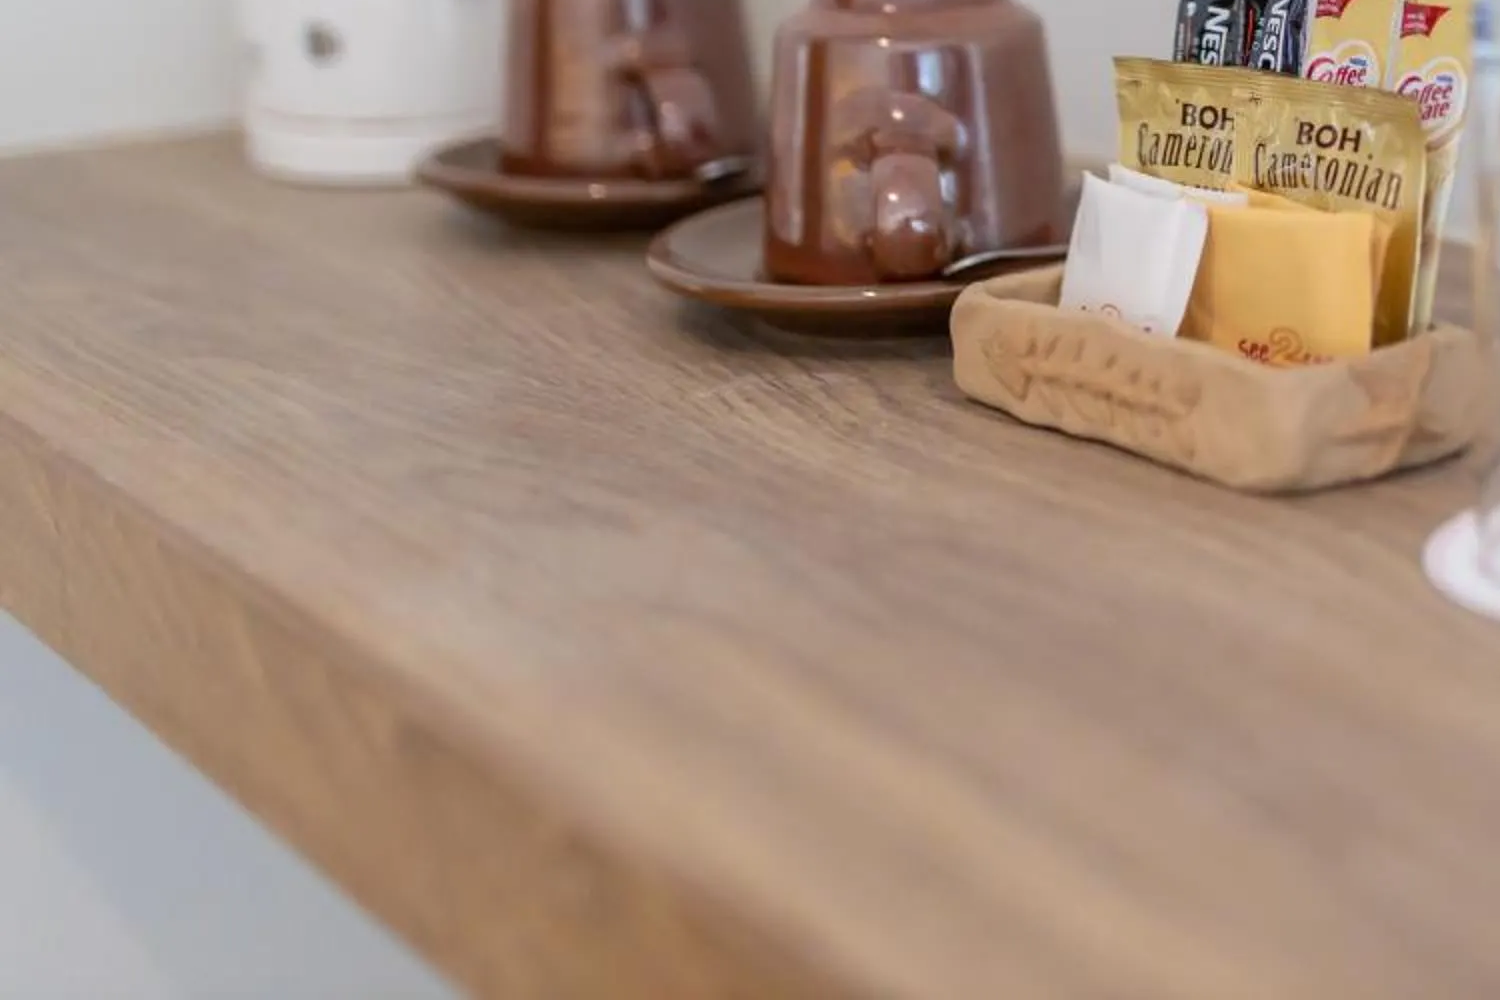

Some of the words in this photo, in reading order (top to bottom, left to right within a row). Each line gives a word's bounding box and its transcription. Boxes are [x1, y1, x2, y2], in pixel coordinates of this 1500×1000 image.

[1181, 103, 1234, 131] BOH
[1296, 121, 1362, 153] BOH
[1254, 143, 1403, 210] Cameronian
